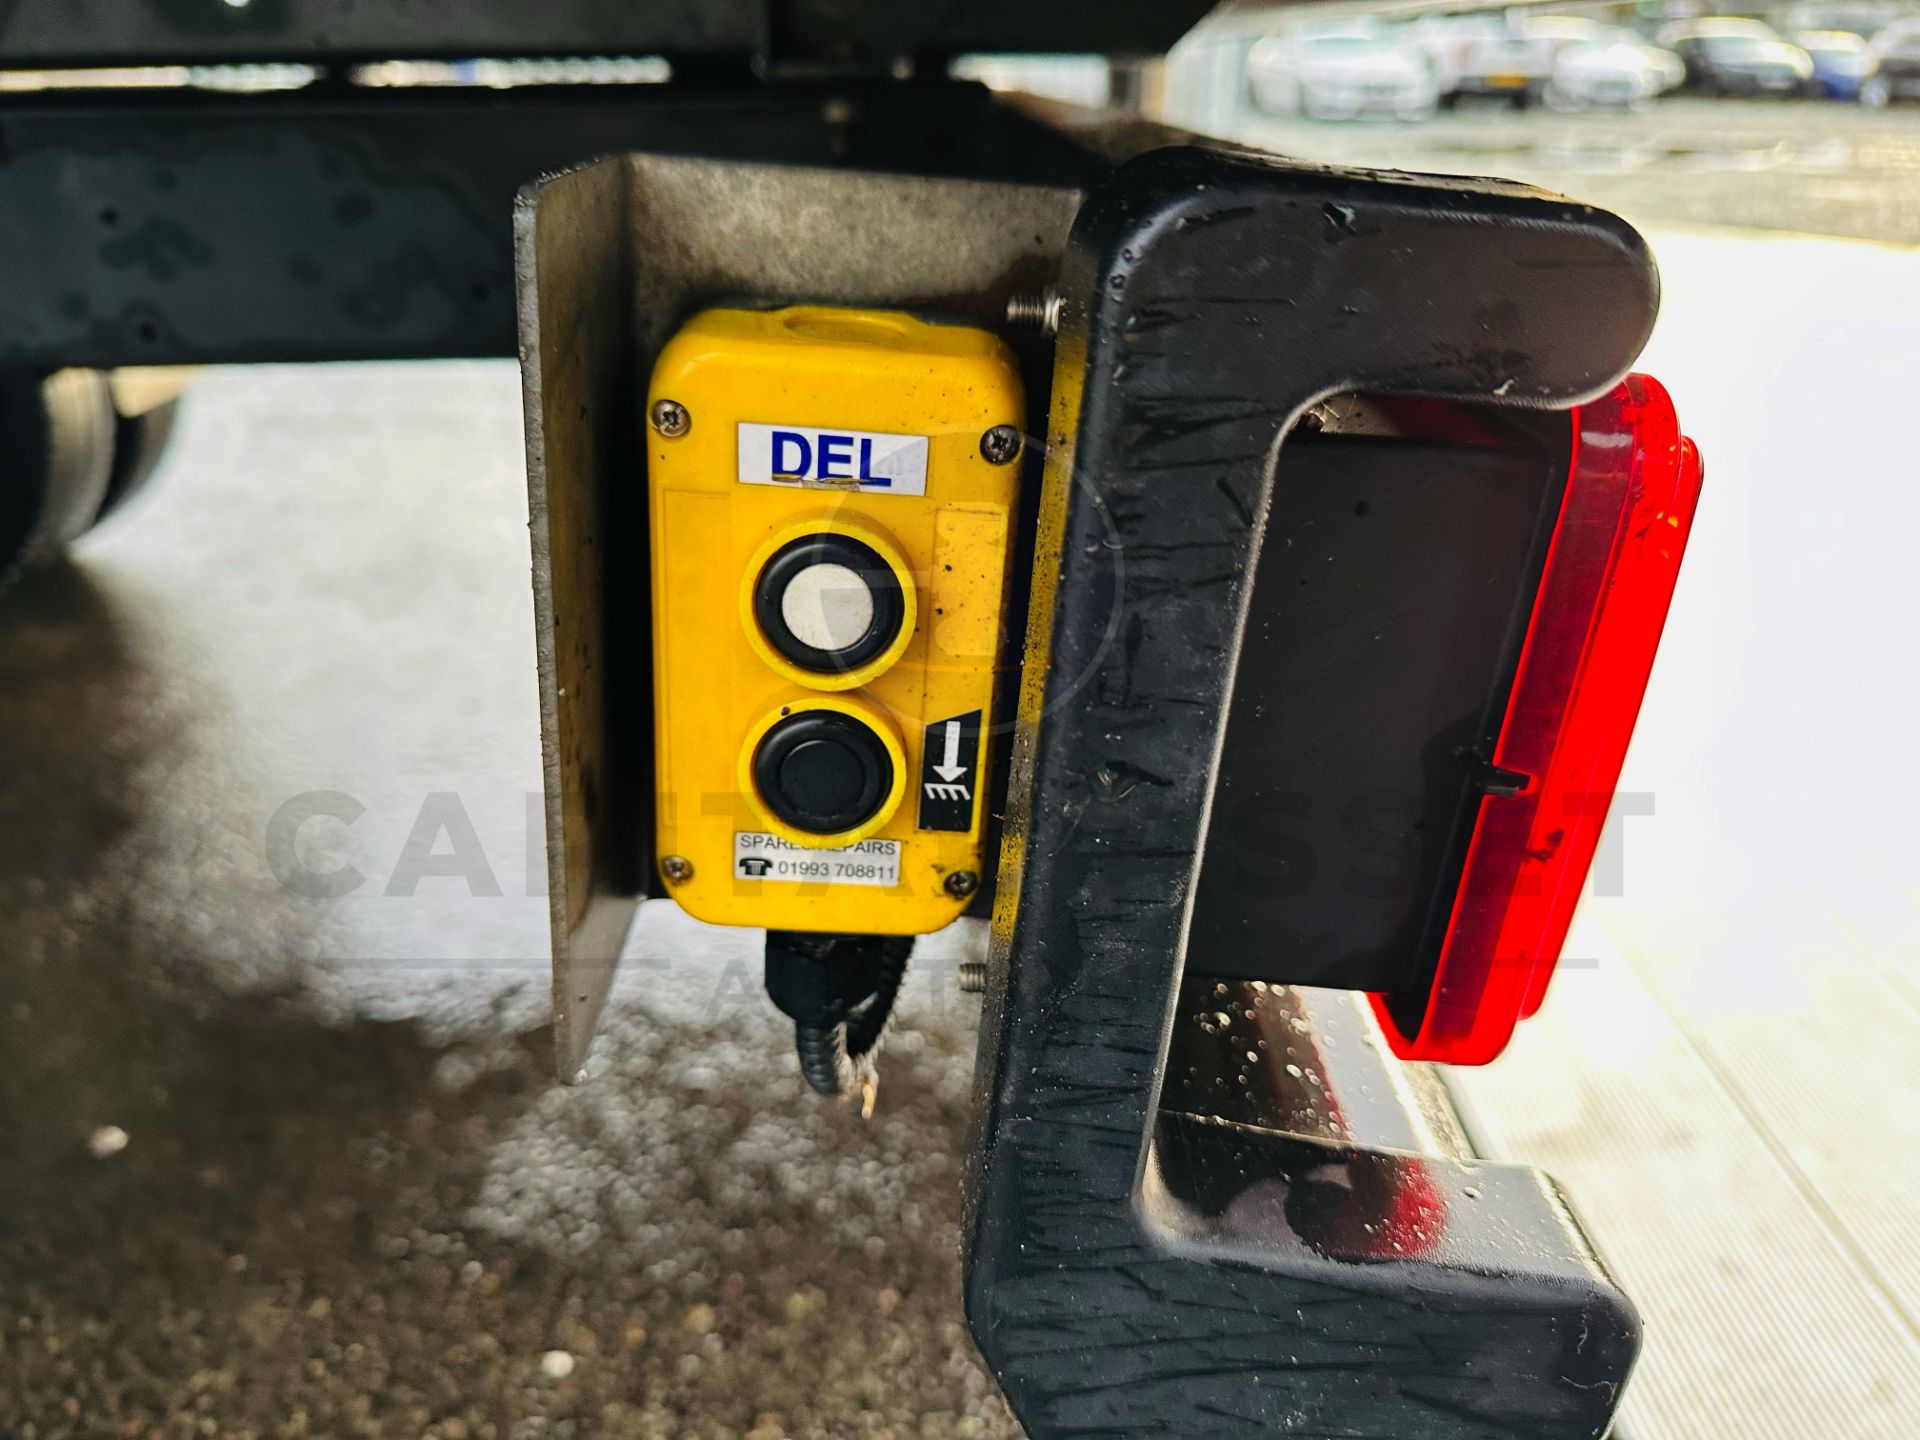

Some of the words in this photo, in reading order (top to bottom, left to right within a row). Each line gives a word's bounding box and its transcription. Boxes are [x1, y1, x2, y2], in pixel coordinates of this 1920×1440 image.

[772, 431, 892, 487] DEL
[778, 861, 830, 877] 01993
[836, 863, 895, 880] 708811
